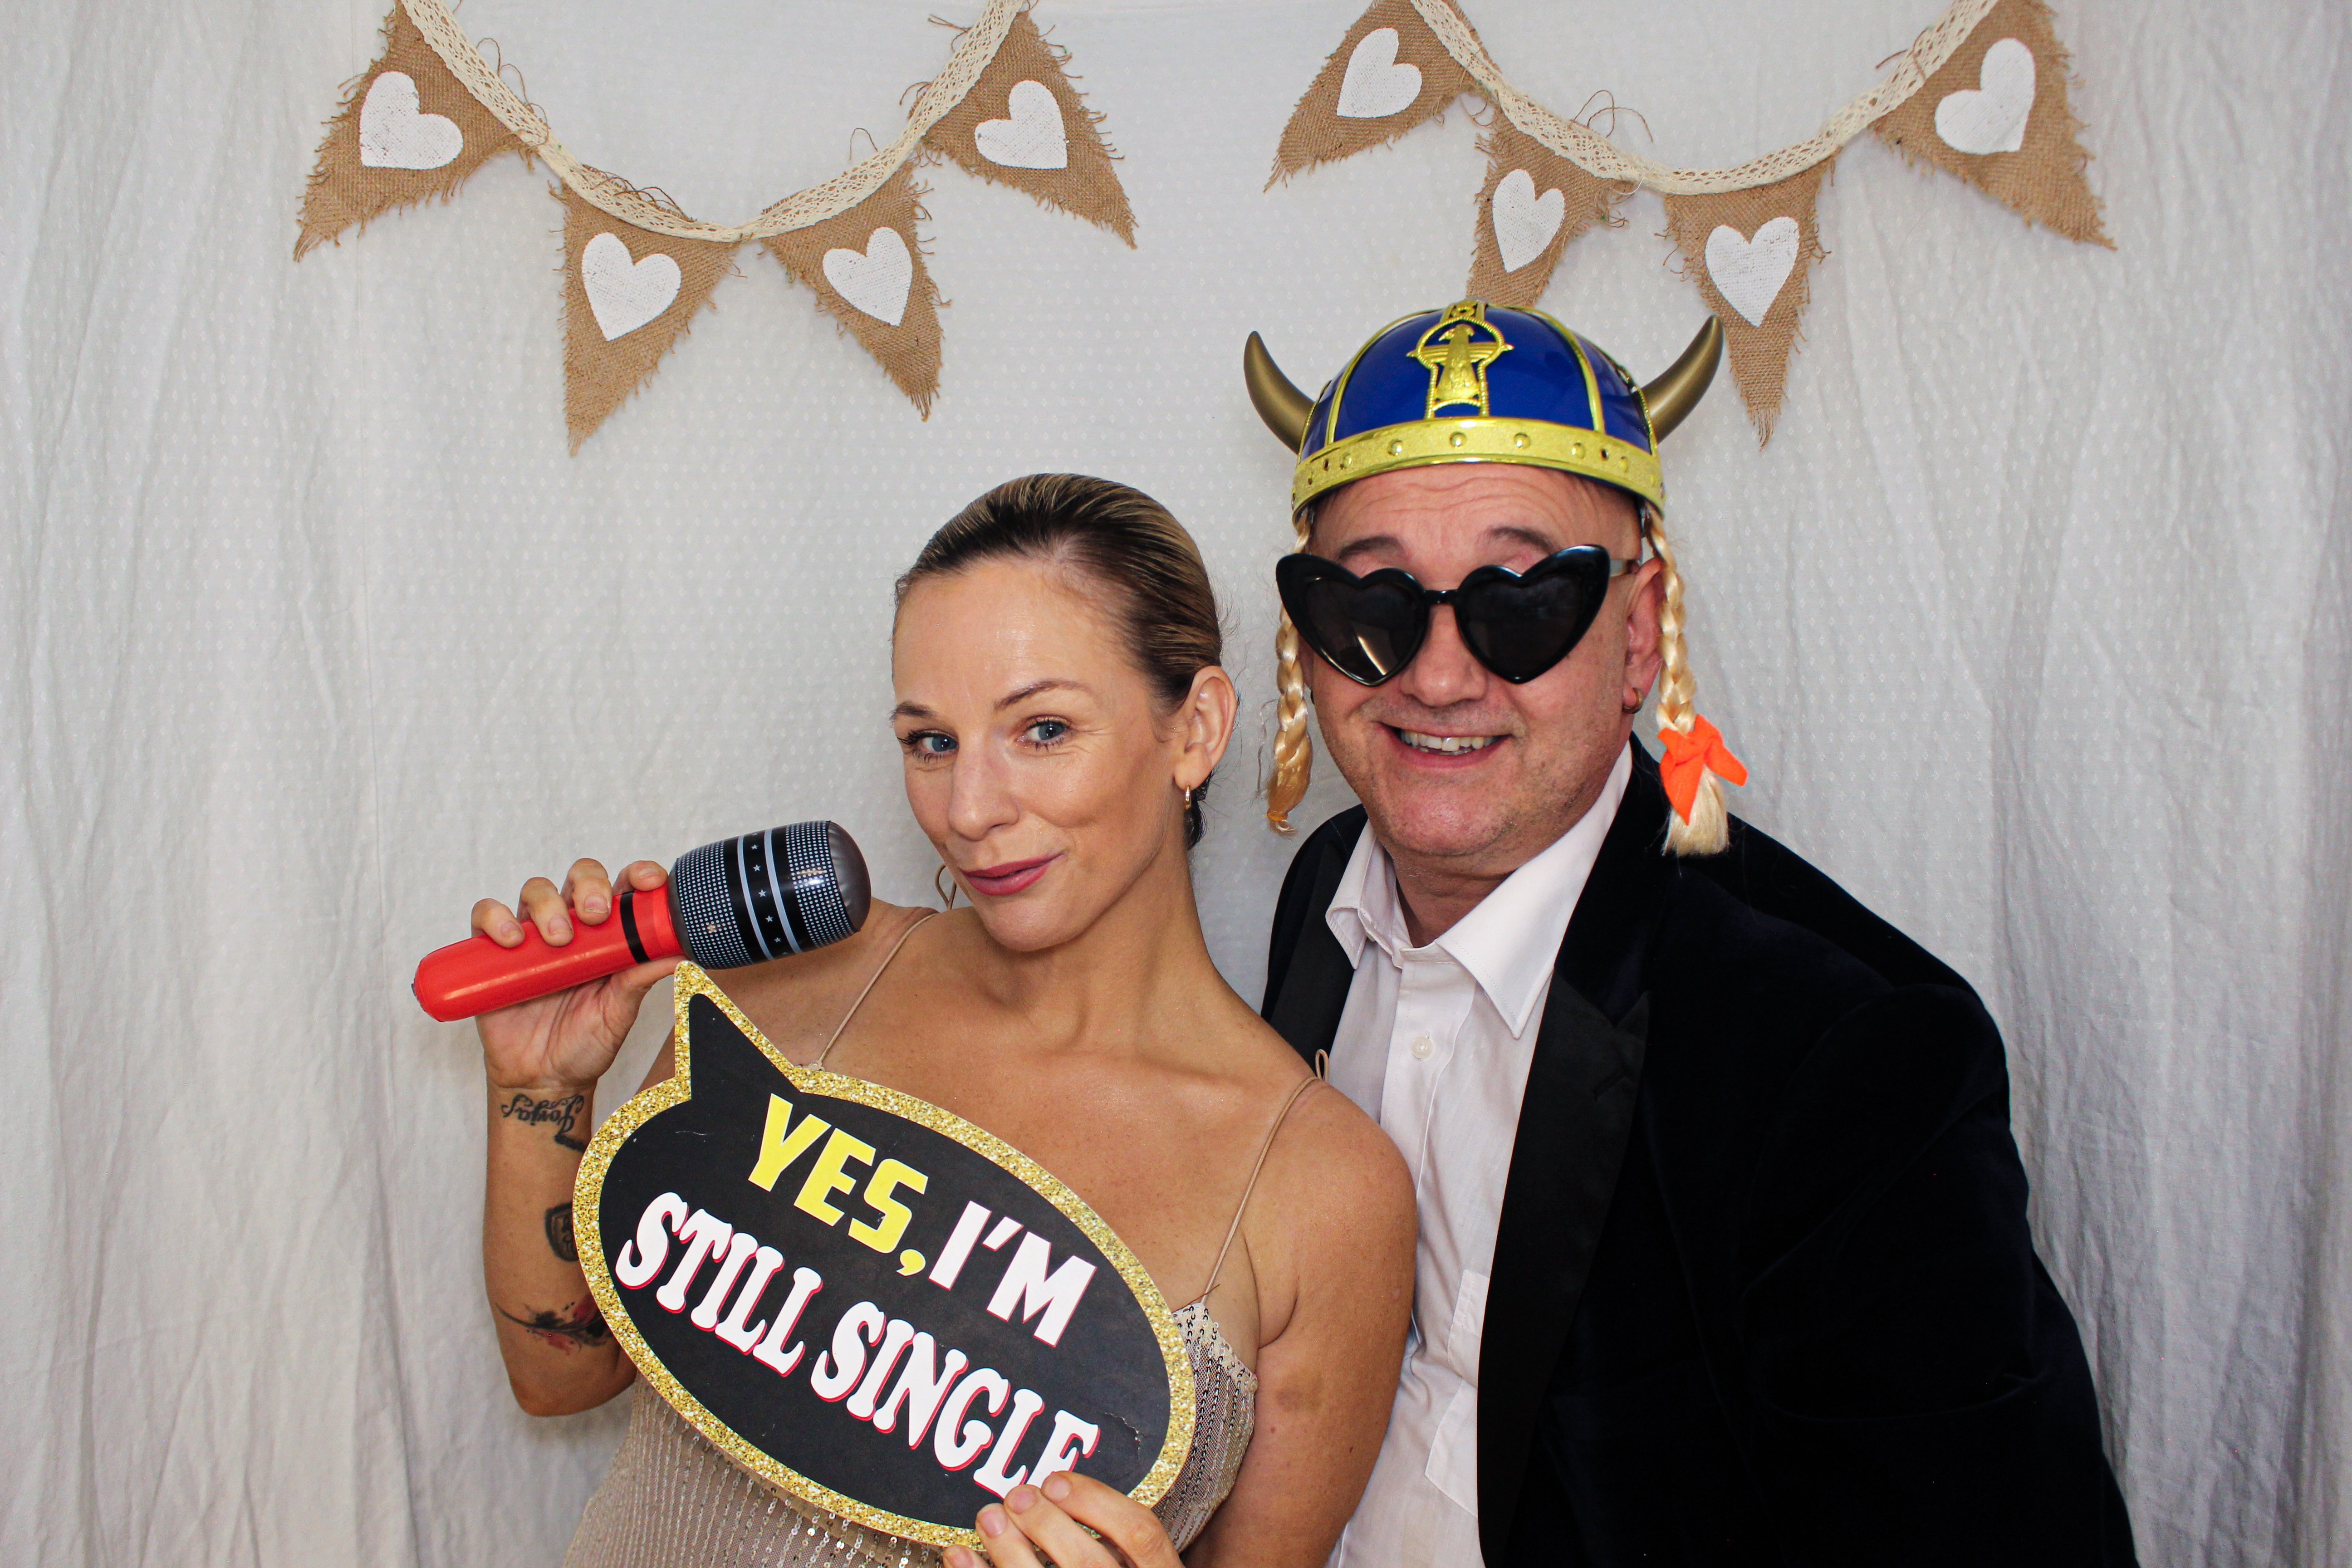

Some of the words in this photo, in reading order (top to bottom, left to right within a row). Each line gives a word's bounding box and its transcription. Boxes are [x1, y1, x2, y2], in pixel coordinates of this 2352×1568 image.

[615, 1192, 823, 1377] STILL
[811, 1301, 1101, 1500] SINGLE
[748, 1093, 929, 1277] YES,
[927, 1200, 1097, 1348] I'M
